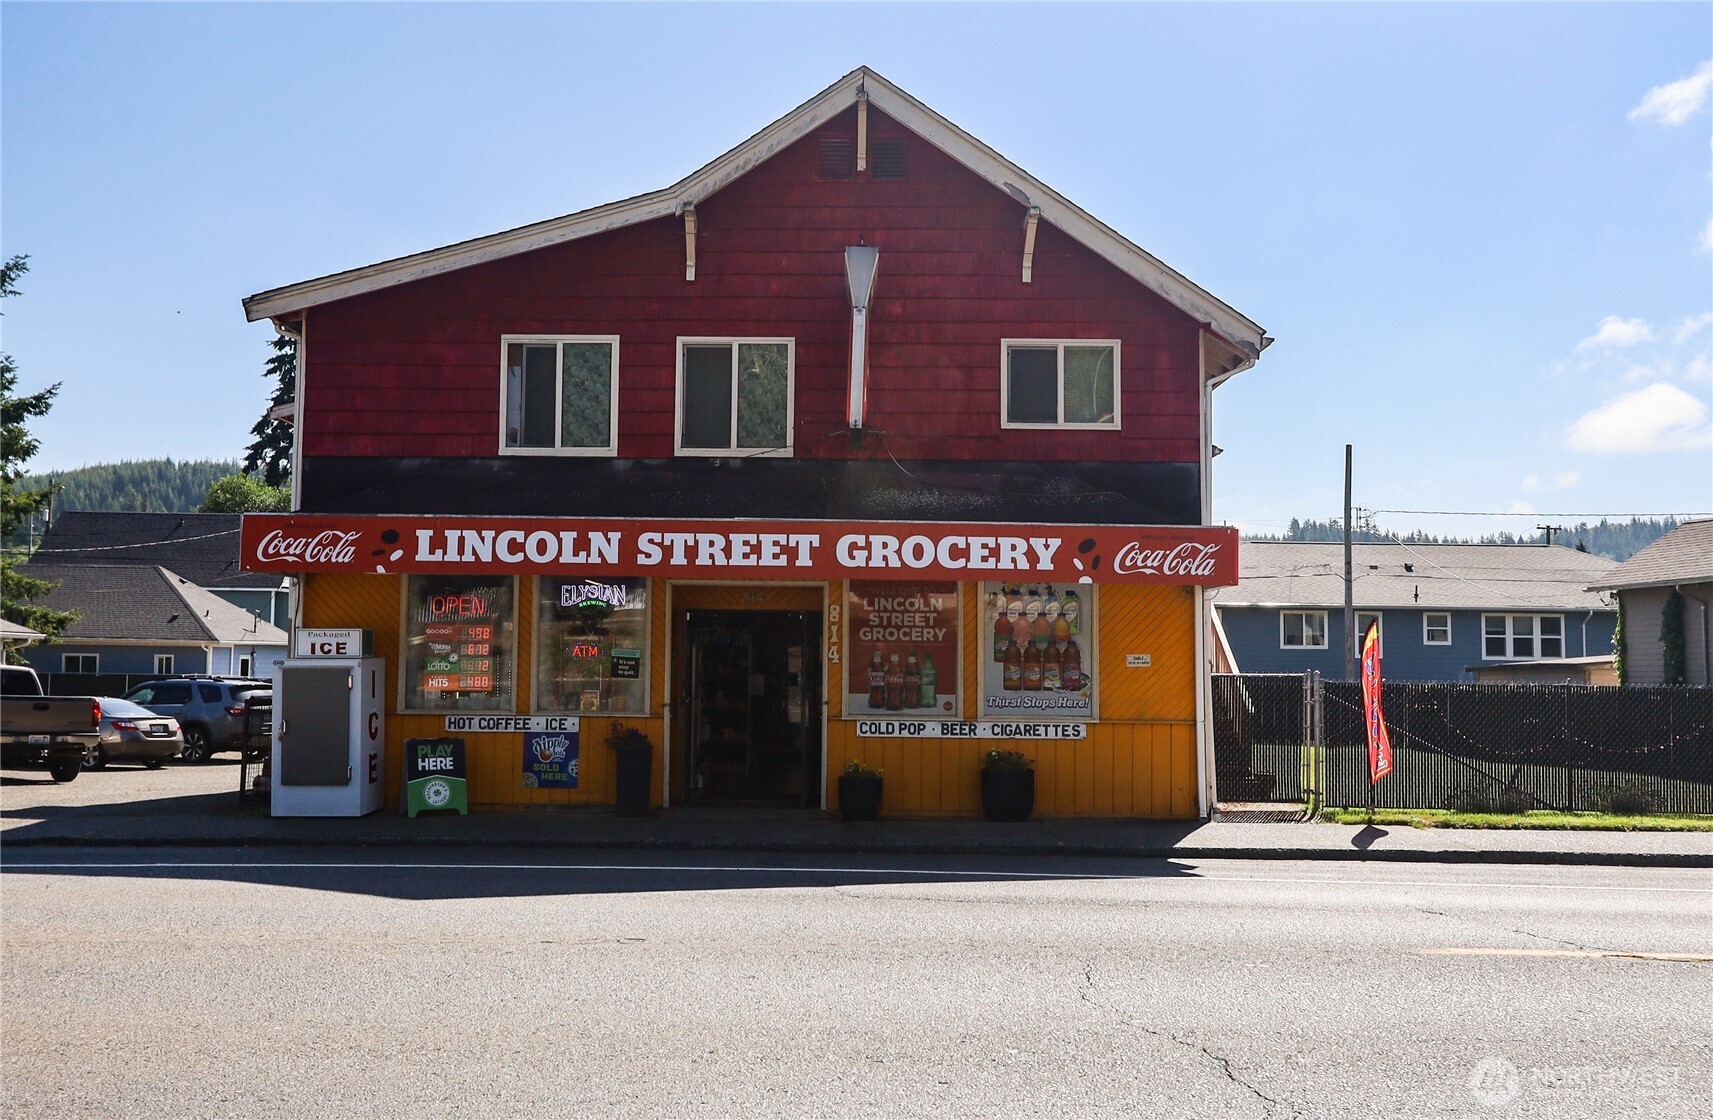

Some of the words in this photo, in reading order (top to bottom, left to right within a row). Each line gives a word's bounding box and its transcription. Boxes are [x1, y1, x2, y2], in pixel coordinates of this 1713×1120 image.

[256, 529, 362, 563] Coca-Cola
[415, 529, 621, 564] LINCOLN
[636, 532, 820, 567] STREET
[835, 534, 1061, 570] GROCERY
[1114, 541, 1222, 576] Coca-Cola
[561, 584, 626, 606] ELYSIAN
[870, 586, 921, 595] WELCOME
[432, 596, 486, 614] OPEN
[578, 599, 607, 608] BREWING
[863, 597, 943, 611] LINCOLN
[869, 612, 937, 626] STREET
[469, 628, 490, 639] 498
[828, 605, 840, 663] 814
[859, 627, 947, 641] GROCERY
[310, 641, 348, 655] ICE
[572, 646, 598, 657] ATM
[427, 661, 451, 671] LOTTO
[428, 678, 449, 687] HIT5
[986, 696, 1022, 709] Thirst
[1023, 697, 1056, 710] Stops
[1057, 697, 1090, 709] Here!
[368, 670, 379, 784] ICE
[447, 717, 474, 730] HOT
[478, 717, 532, 730] COFFEE
[545, 718, 568, 730] ICE
[859, 722, 895, 735] COLD
[898, 723, 926, 735] POP
[941, 723, 977, 736] BEER
[991, 723, 1081, 737] CIGARETTES
[417, 744, 454, 757] PLAY
[417, 757, 454, 771] HERE
[533, 763, 559, 771] SOLD
[541, 773, 569, 781] HERE
